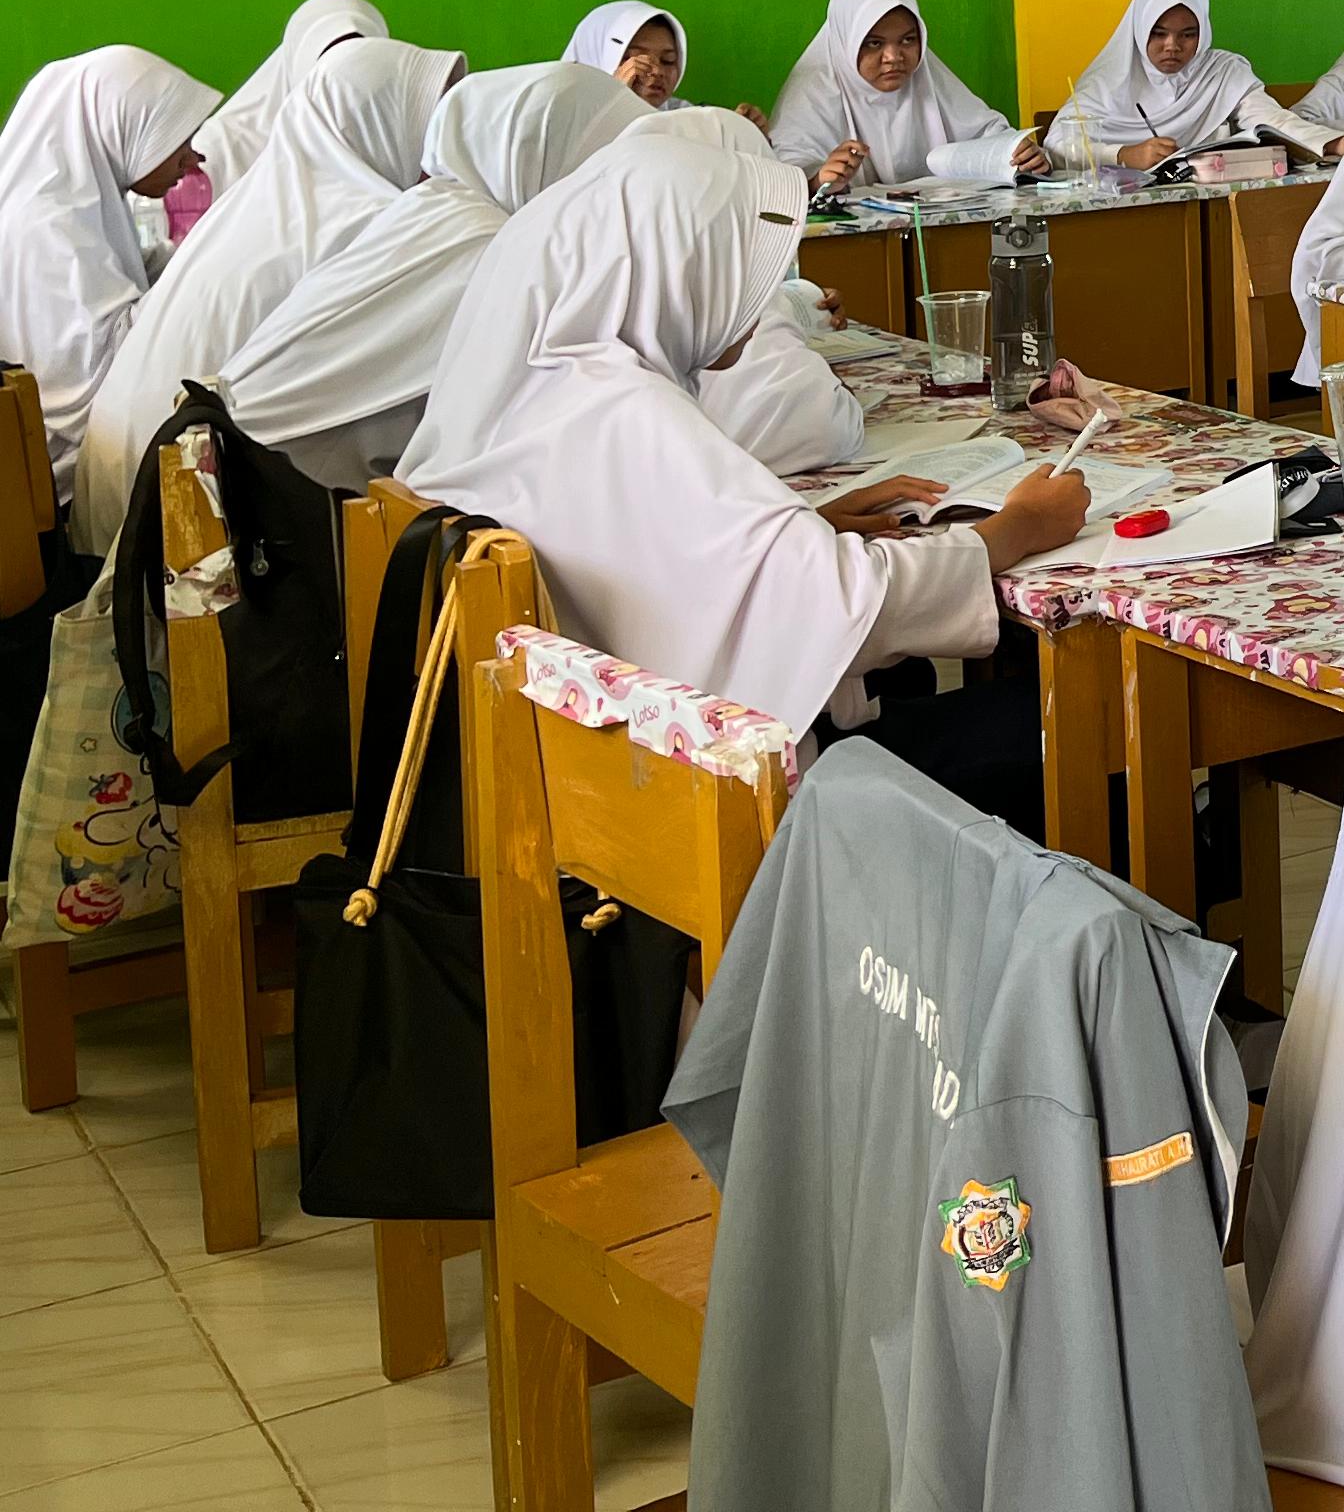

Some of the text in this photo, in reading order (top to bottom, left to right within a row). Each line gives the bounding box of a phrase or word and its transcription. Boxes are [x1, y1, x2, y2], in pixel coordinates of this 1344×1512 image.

[529, 661, 557, 685] Lotso
[630, 702, 660, 729] Lotso
[859, 945, 909, 1021] OSIM
